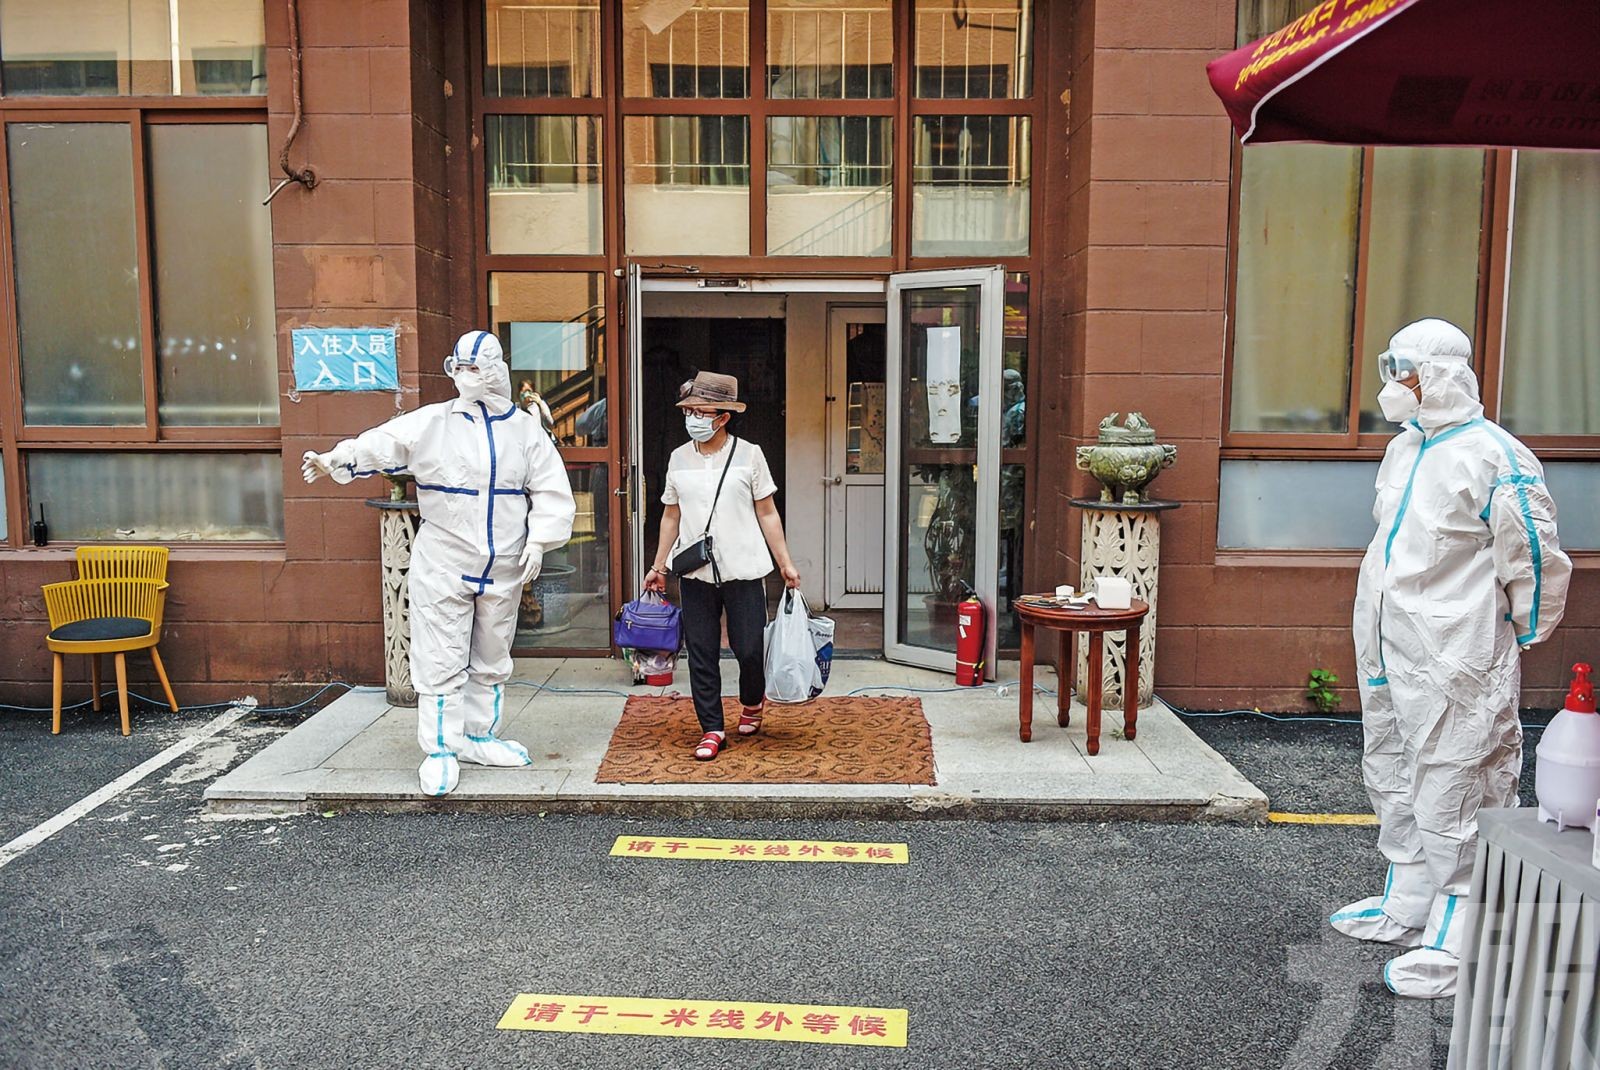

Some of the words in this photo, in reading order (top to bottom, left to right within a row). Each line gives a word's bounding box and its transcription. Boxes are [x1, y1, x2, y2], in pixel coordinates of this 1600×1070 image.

[300, 335, 388, 356] 入住人员
[313, 360, 377, 386] 入口
[626, 839, 895, 860] 请于一米线外等候
[524, 1002, 889, 1038] 请于一米线外等候
